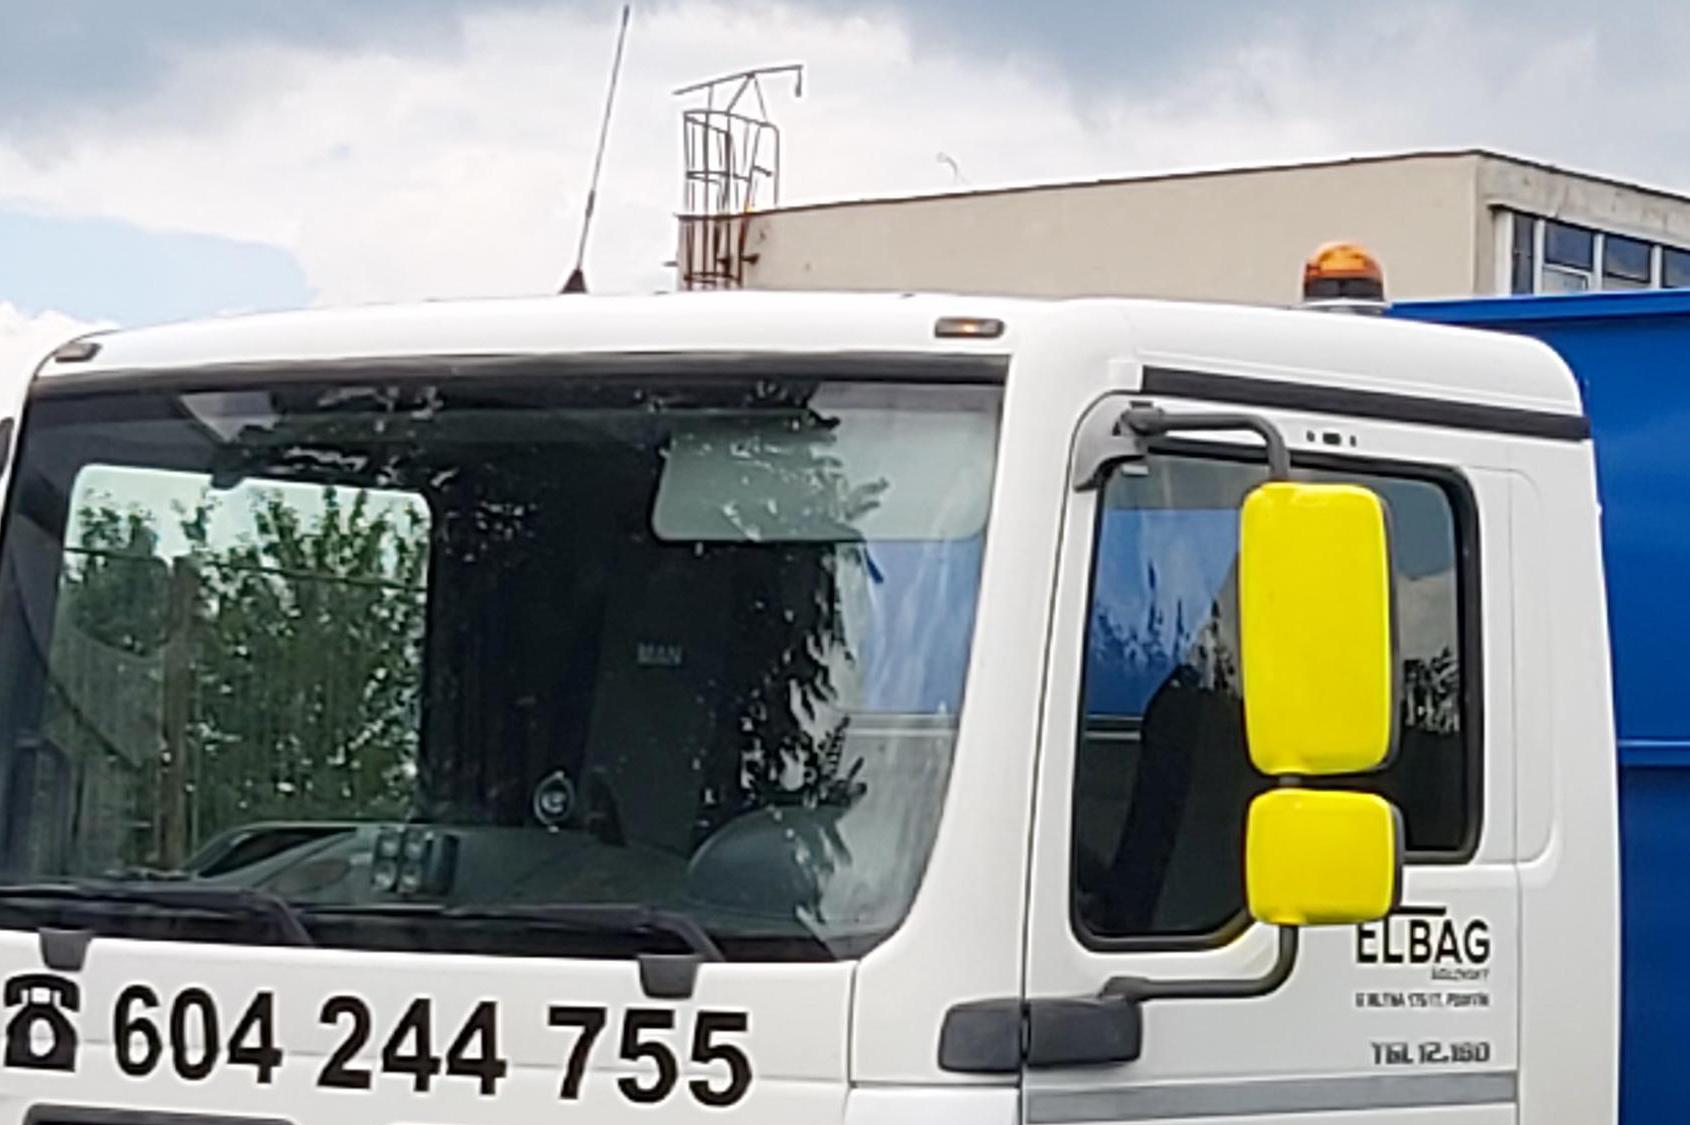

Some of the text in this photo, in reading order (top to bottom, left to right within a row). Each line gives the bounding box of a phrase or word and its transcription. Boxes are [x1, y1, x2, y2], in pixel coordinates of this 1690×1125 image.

[1356, 917, 1491, 965] ELBAG
[113, 984, 752, 1107] 604 244 755
